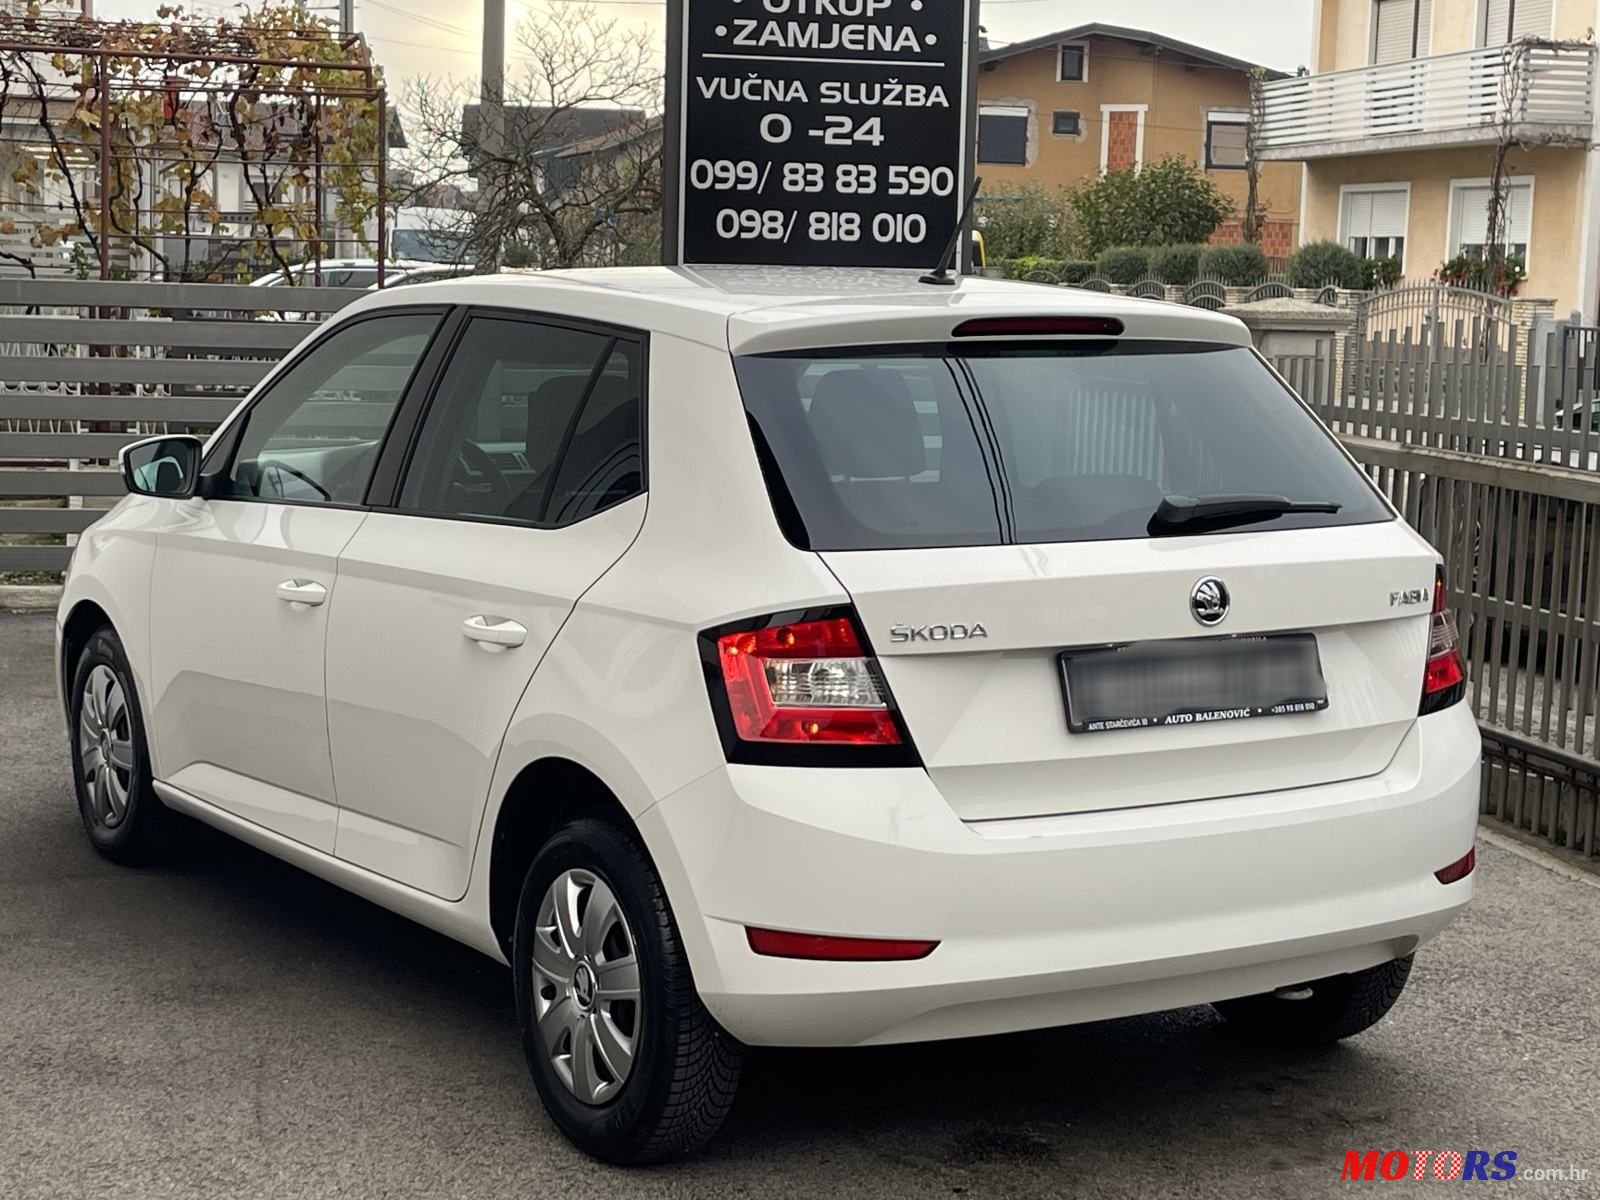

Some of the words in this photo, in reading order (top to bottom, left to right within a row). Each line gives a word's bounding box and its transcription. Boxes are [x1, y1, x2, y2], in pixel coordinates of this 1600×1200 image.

[732, 18, 921, 53] ZAMJENA
[695, 72, 809, 103] VUČNA
[819, 78, 949, 108] SLUŽBA
[690, 159, 772, 195] 099/
[782, 162, 825, 193] 83
[835, 164, 877, 194] 83
[888, 165, 954, 197] 590
[716, 208, 797, 244] 098/
[808, 211, 861, 242] 818
[872, 213, 927, 244] 010
[890, 622, 988, 642] ŠKODA
[1164, 713, 1193, 725] AUTO
[1195, 706, 1251, 722] BALENOVIĆ
